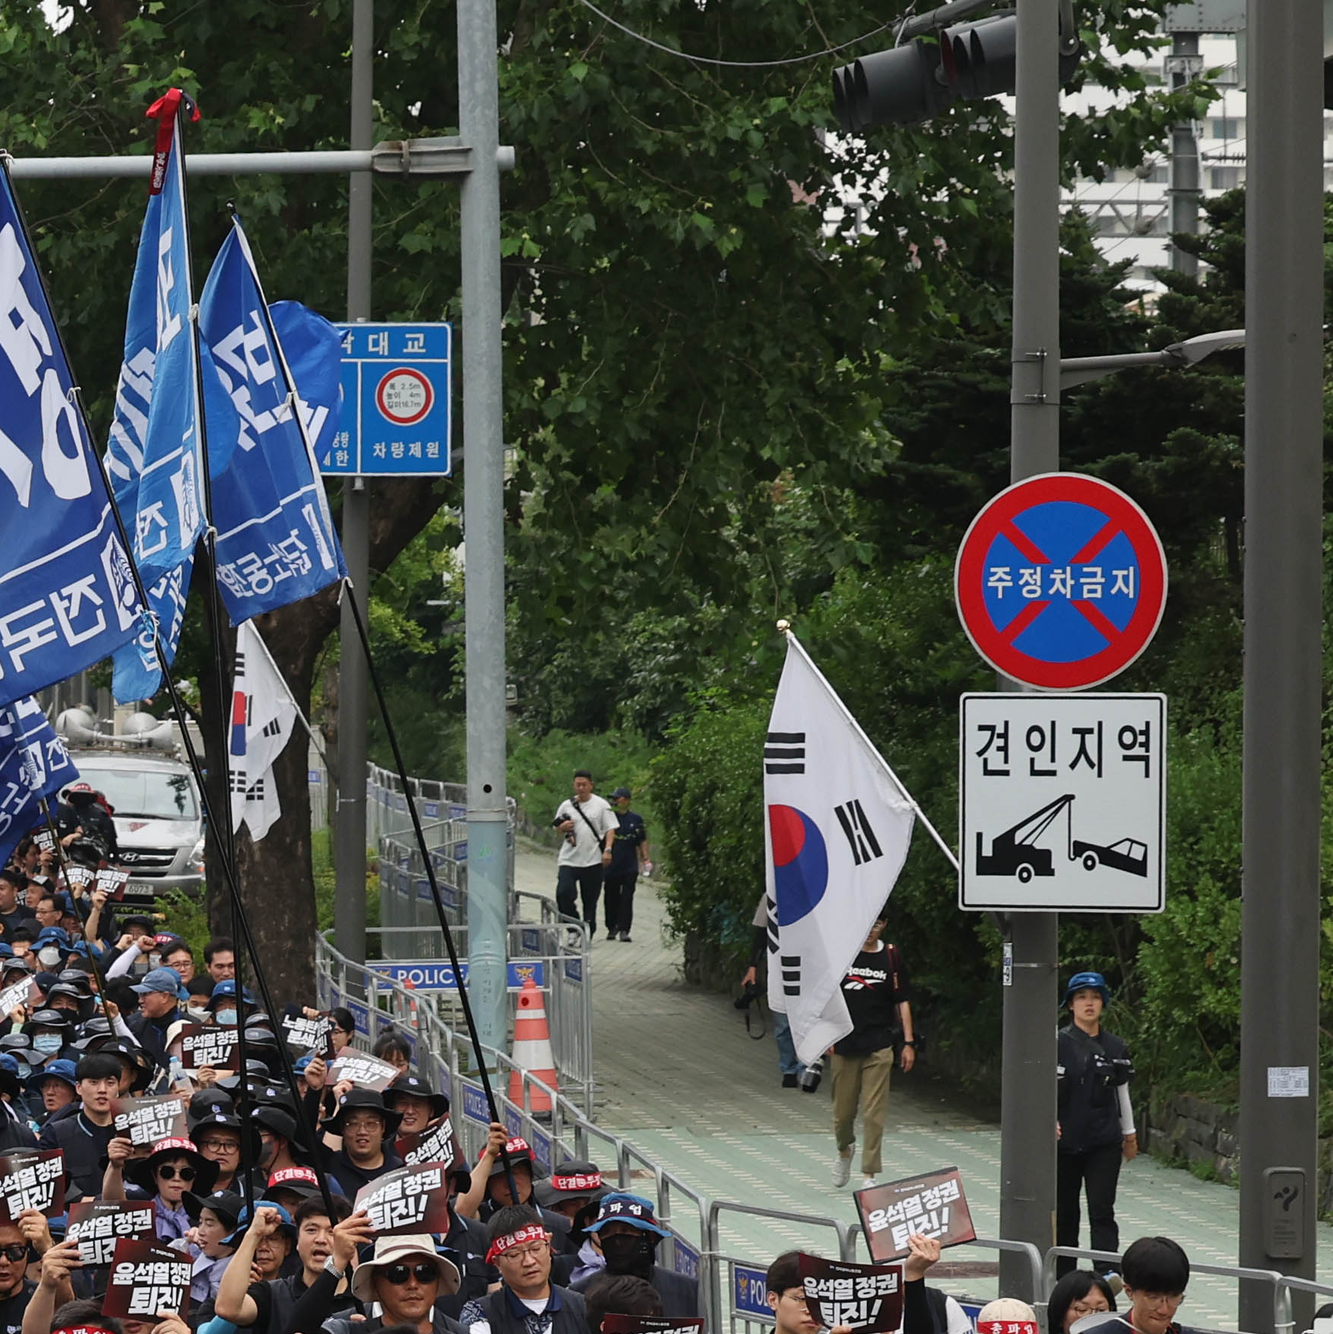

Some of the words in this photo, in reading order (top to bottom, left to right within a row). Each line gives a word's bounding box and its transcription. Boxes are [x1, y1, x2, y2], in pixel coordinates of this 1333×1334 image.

[373, 441, 440, 459] 차량제원
[987, 565, 1135, 600] 주정차금지
[975, 720, 1151, 779] 견인지역
[397, 967, 466, 990] POLICE
[867, 1195, 928, 1234] 윤석열
[923, 1178, 962, 1212] 정권
[890, 1211, 951, 1252] 퇴진!
[802, 1273, 855, 1302] 윤석열
[854, 1270, 900, 1298] 정권
[819, 1298, 883, 1330] 퇴진!
